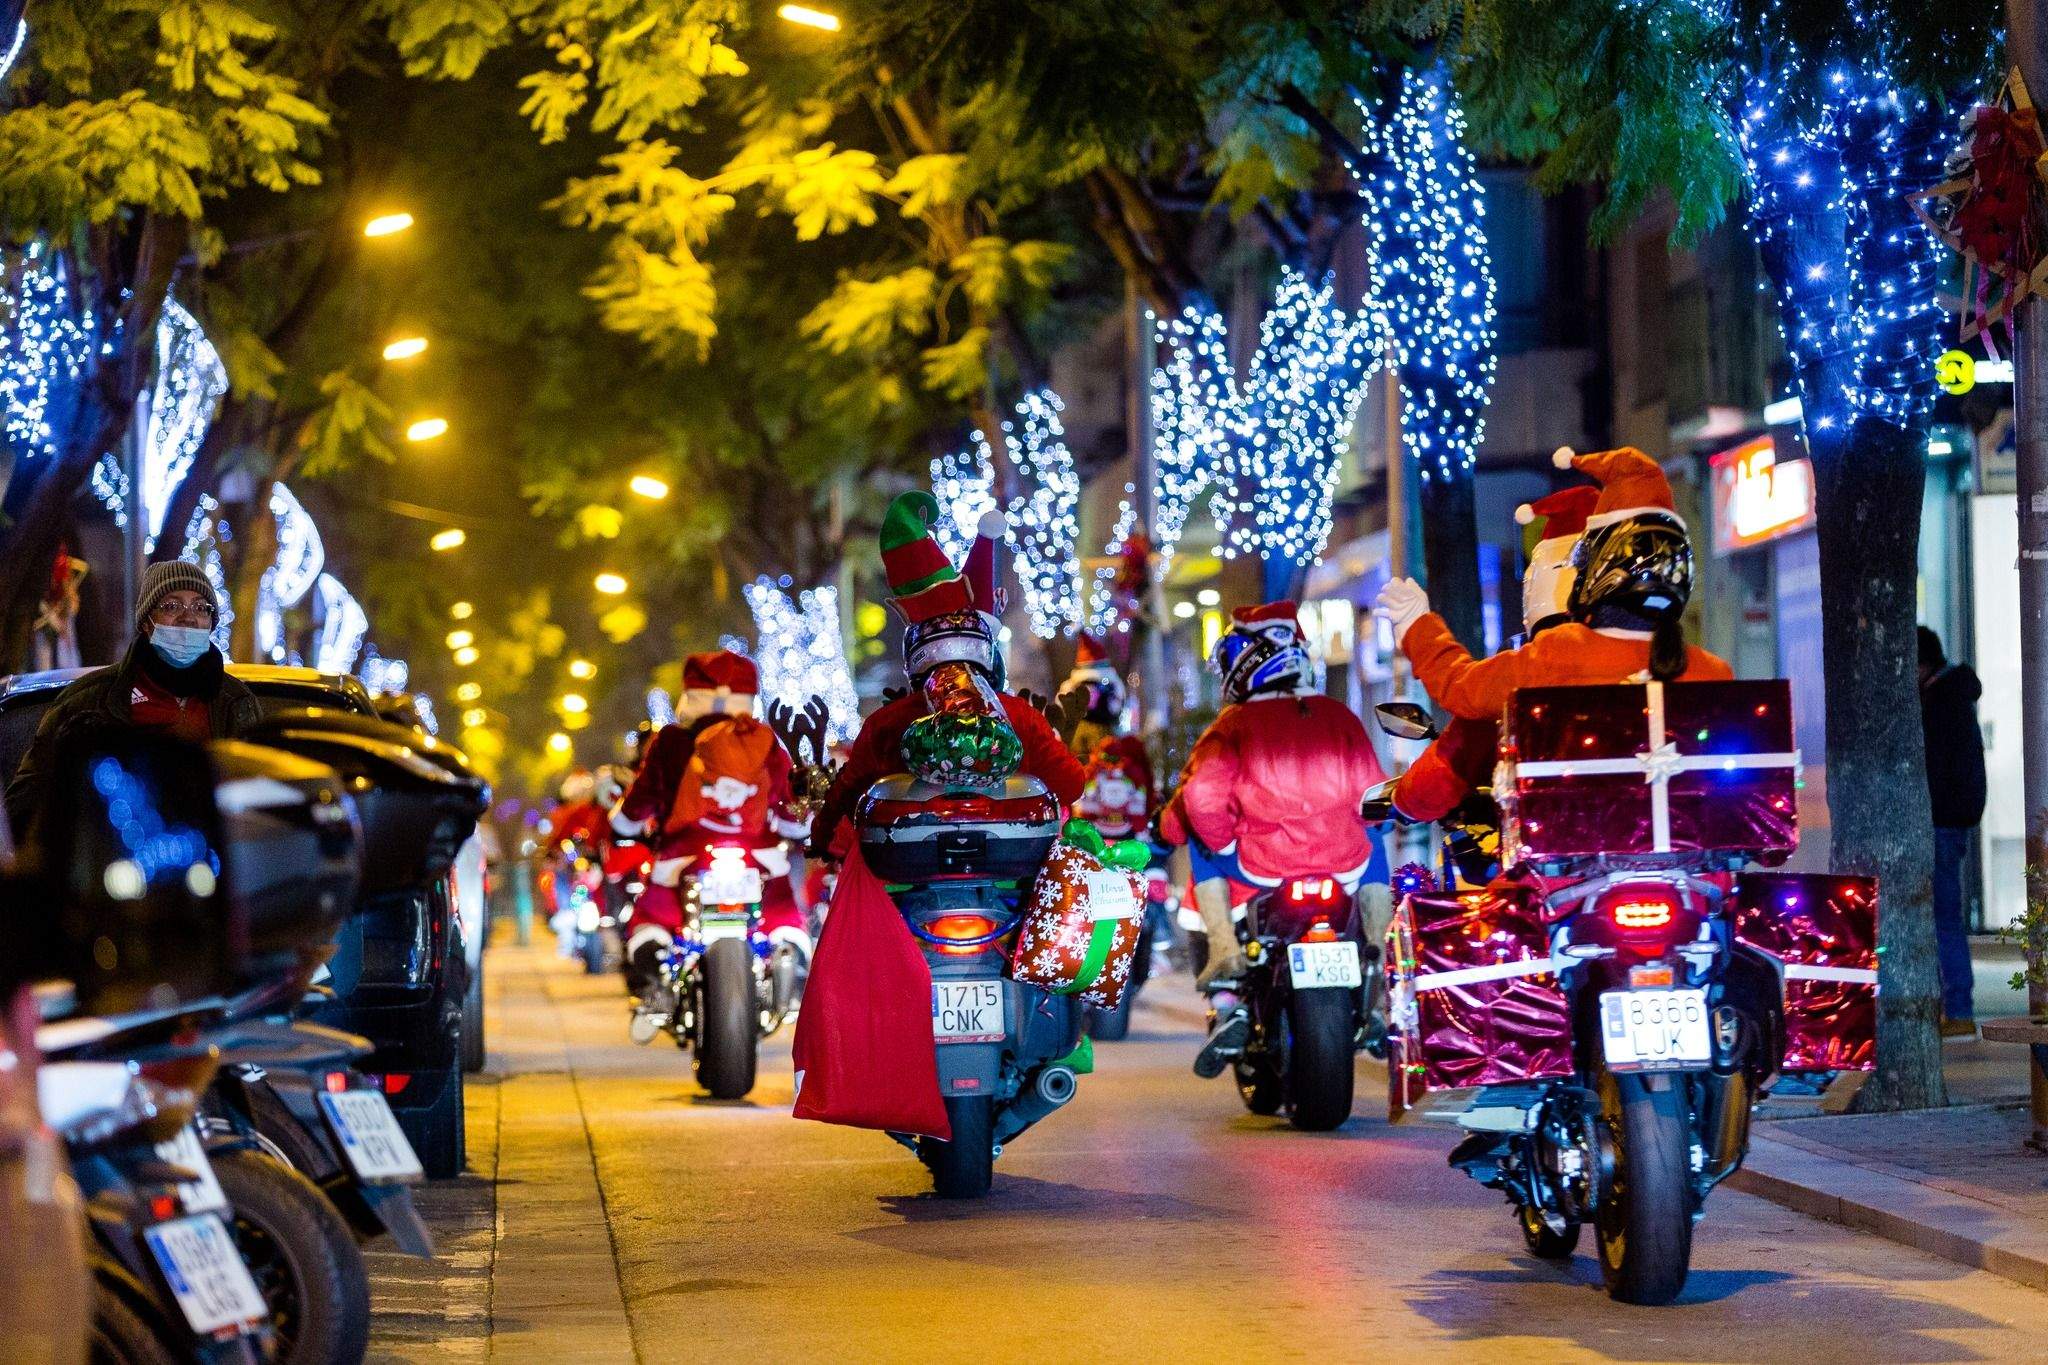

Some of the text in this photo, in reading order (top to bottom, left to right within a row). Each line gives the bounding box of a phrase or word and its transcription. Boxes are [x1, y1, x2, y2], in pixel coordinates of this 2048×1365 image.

[1311, 948, 1352, 963] 1531
[1315, 965, 1350, 982] KSG
[943, 985, 998, 1007] 1715
[942, 1009, 984, 1031] CNK
[1630, 997, 1699, 1025] 8366
[1633, 1028, 1684, 1055] LJK
